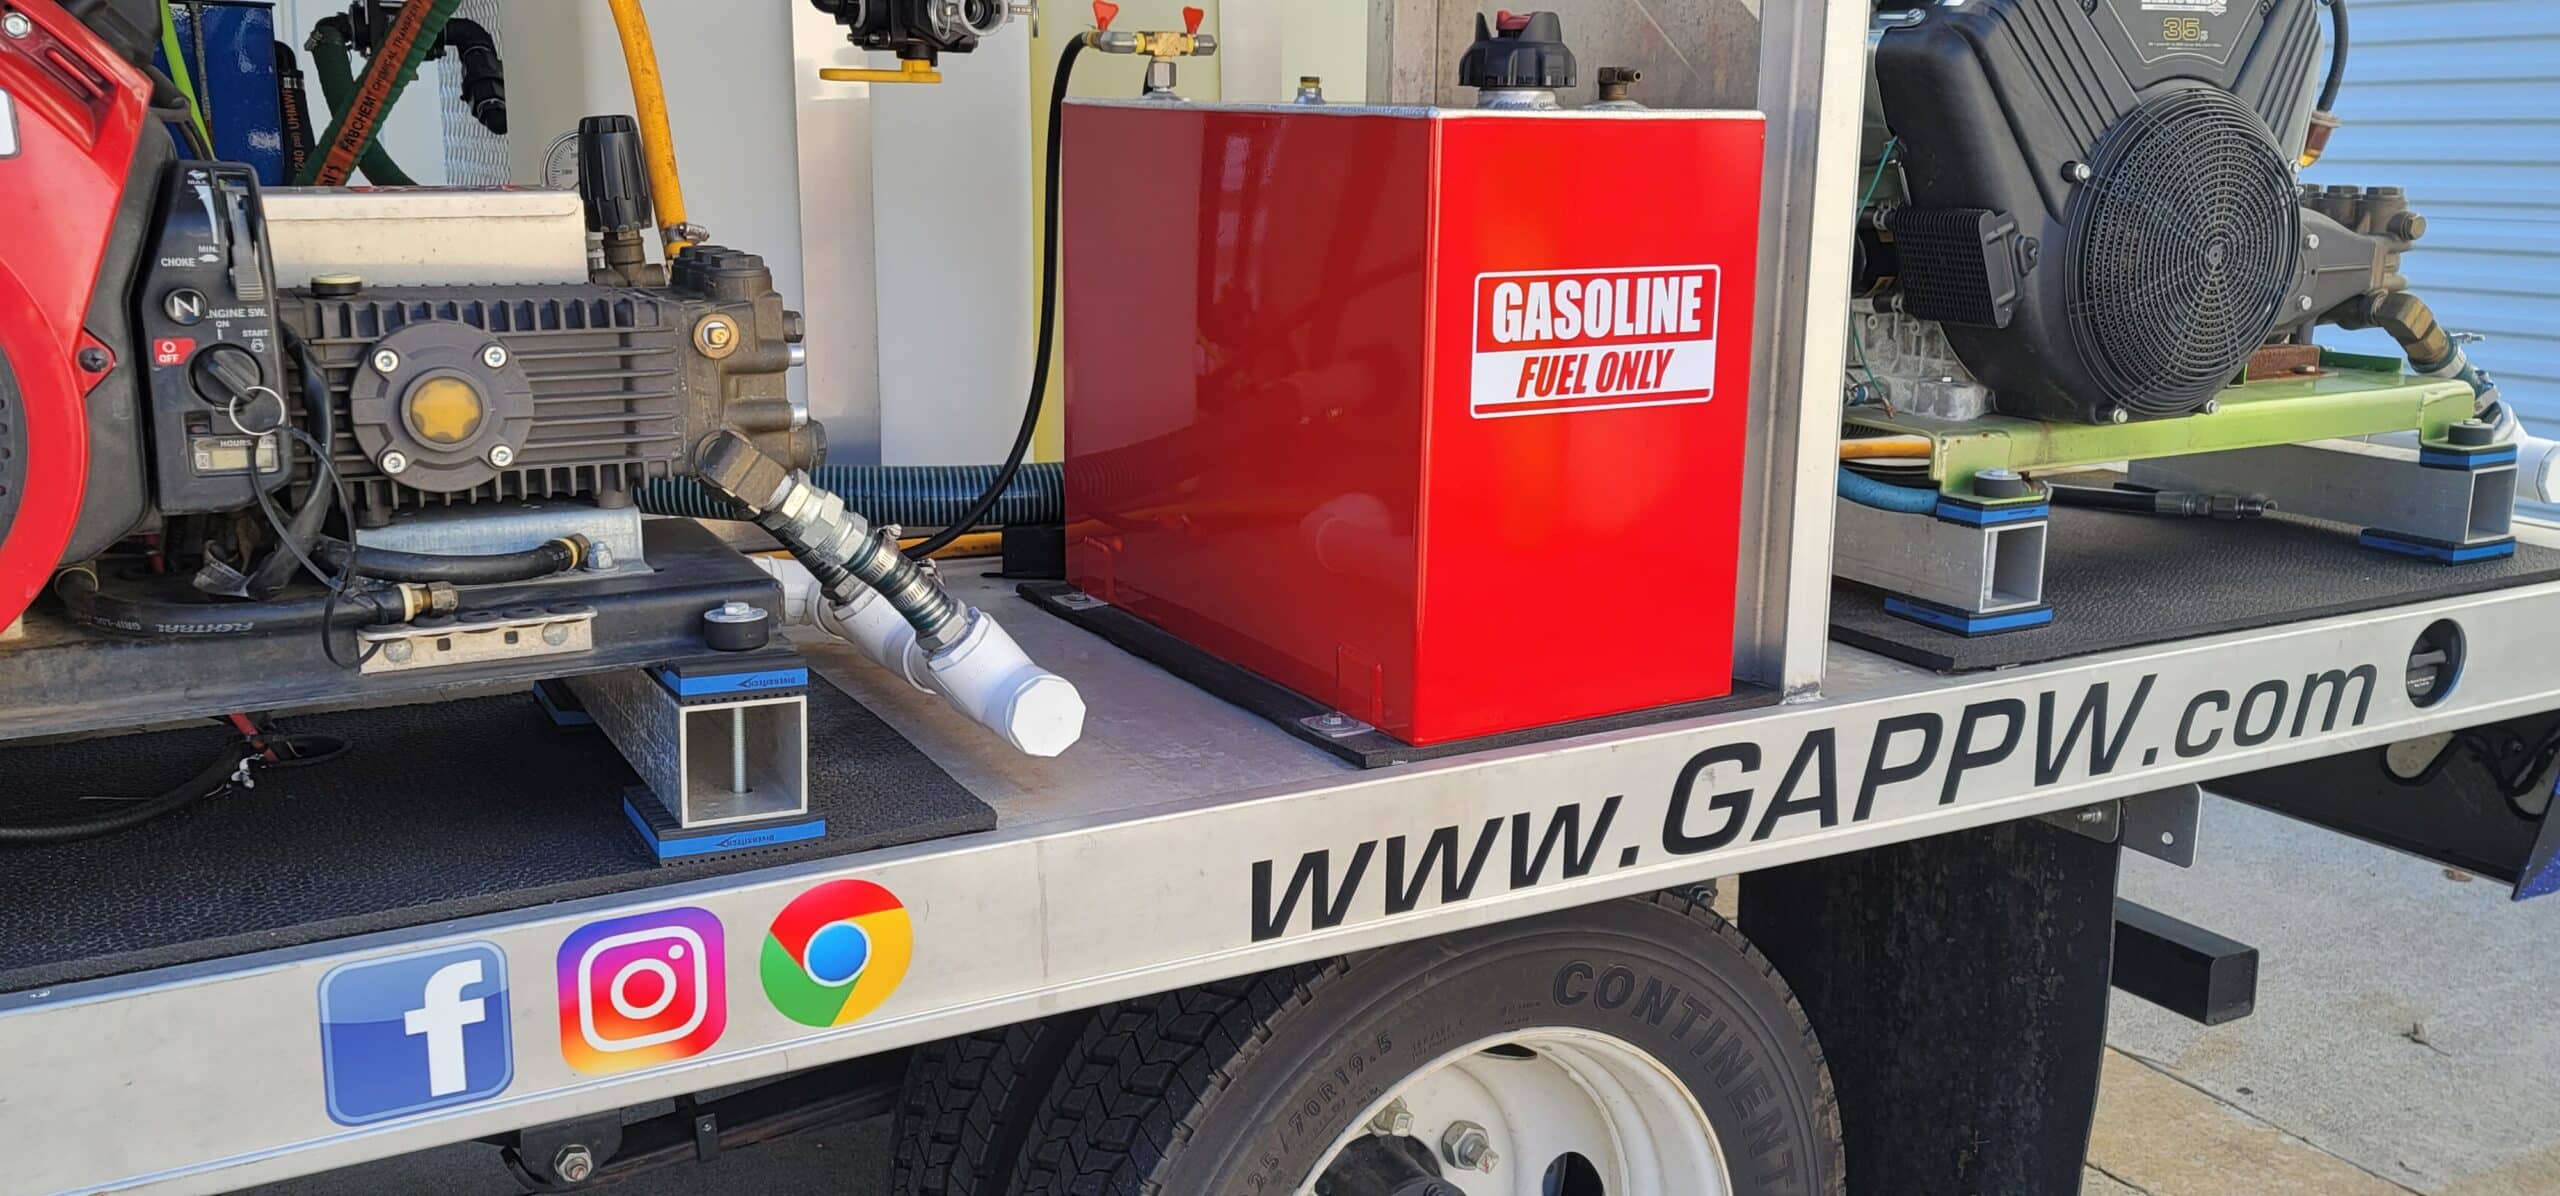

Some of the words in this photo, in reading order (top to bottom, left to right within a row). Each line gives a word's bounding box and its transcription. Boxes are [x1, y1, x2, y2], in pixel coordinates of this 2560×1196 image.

[340, 96, 377, 153] FABCHEM
[160, 257, 196, 267] CHOKE
[205, 309, 246, 319] NGINE
[242, 329, 269, 338] START
[1492, 275, 1703, 343] GASOLINE
[158, 353, 179, 363] OFF
[1516, 353, 1589, 398] FUEL
[1595, 349, 1675, 393] ONLY
[1251, 663, 2377, 942] www.GAPPW.com
[1240, 1030, 1394, 1196] 25/70R19.5
